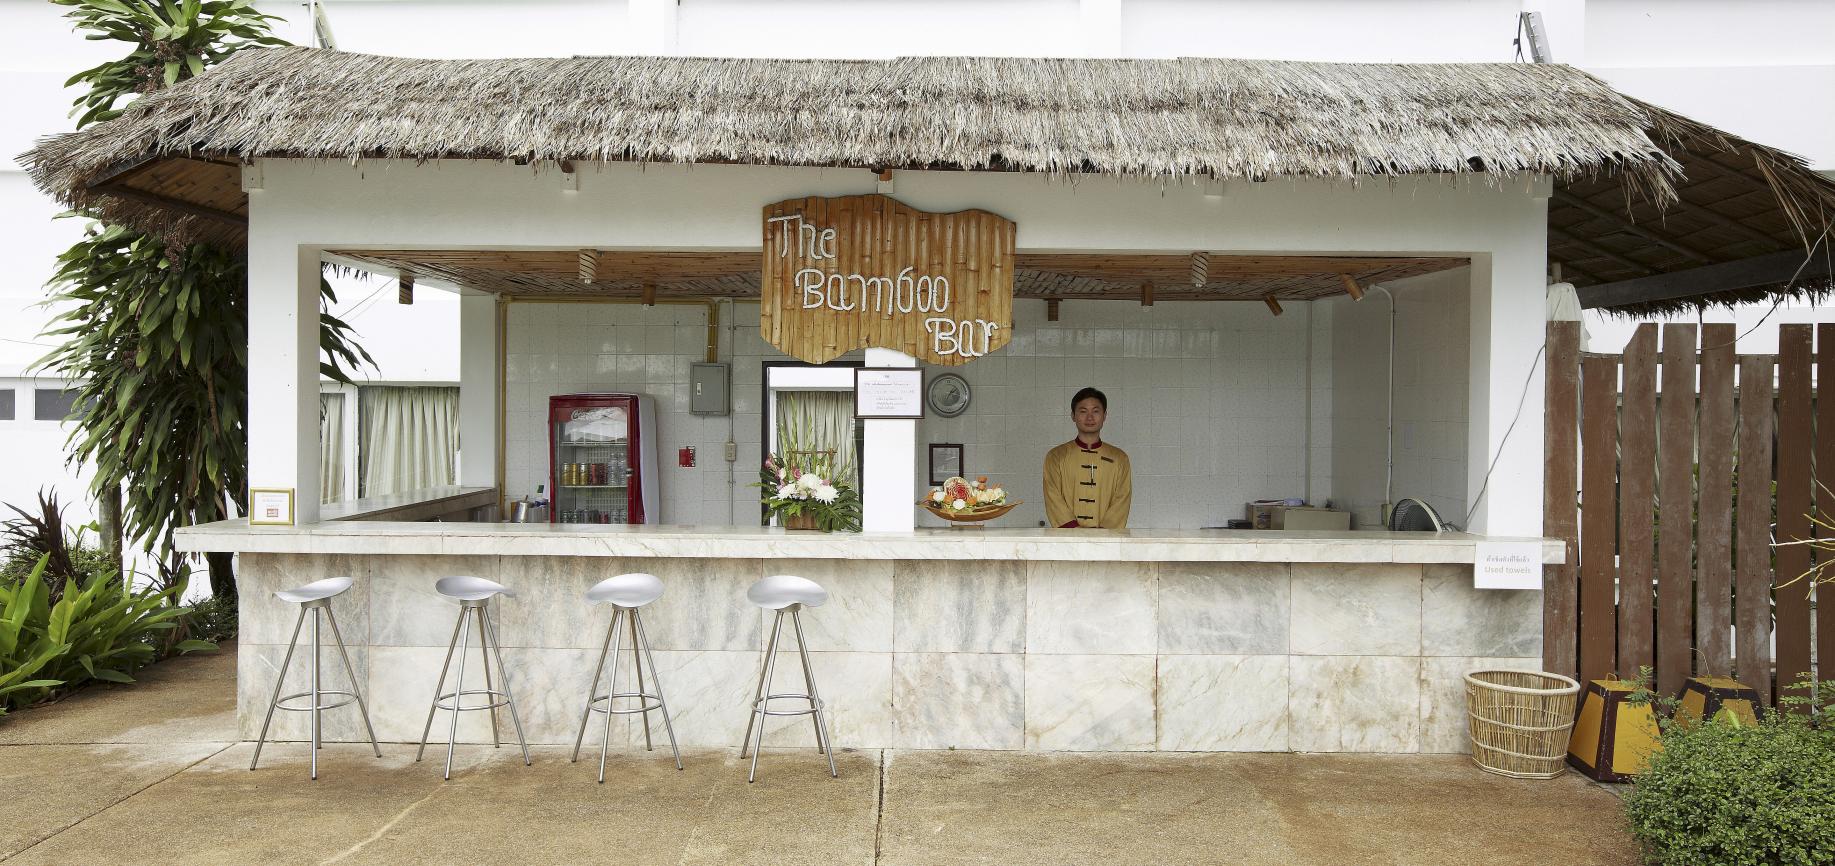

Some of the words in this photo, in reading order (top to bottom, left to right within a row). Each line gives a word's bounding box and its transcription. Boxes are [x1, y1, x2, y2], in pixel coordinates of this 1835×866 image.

[768, 214, 837, 260] The
[795, 266, 949, 315] Bamboo
[924, 317, 998, 357] Bar
[1484, 566, 1504, 574] Used
